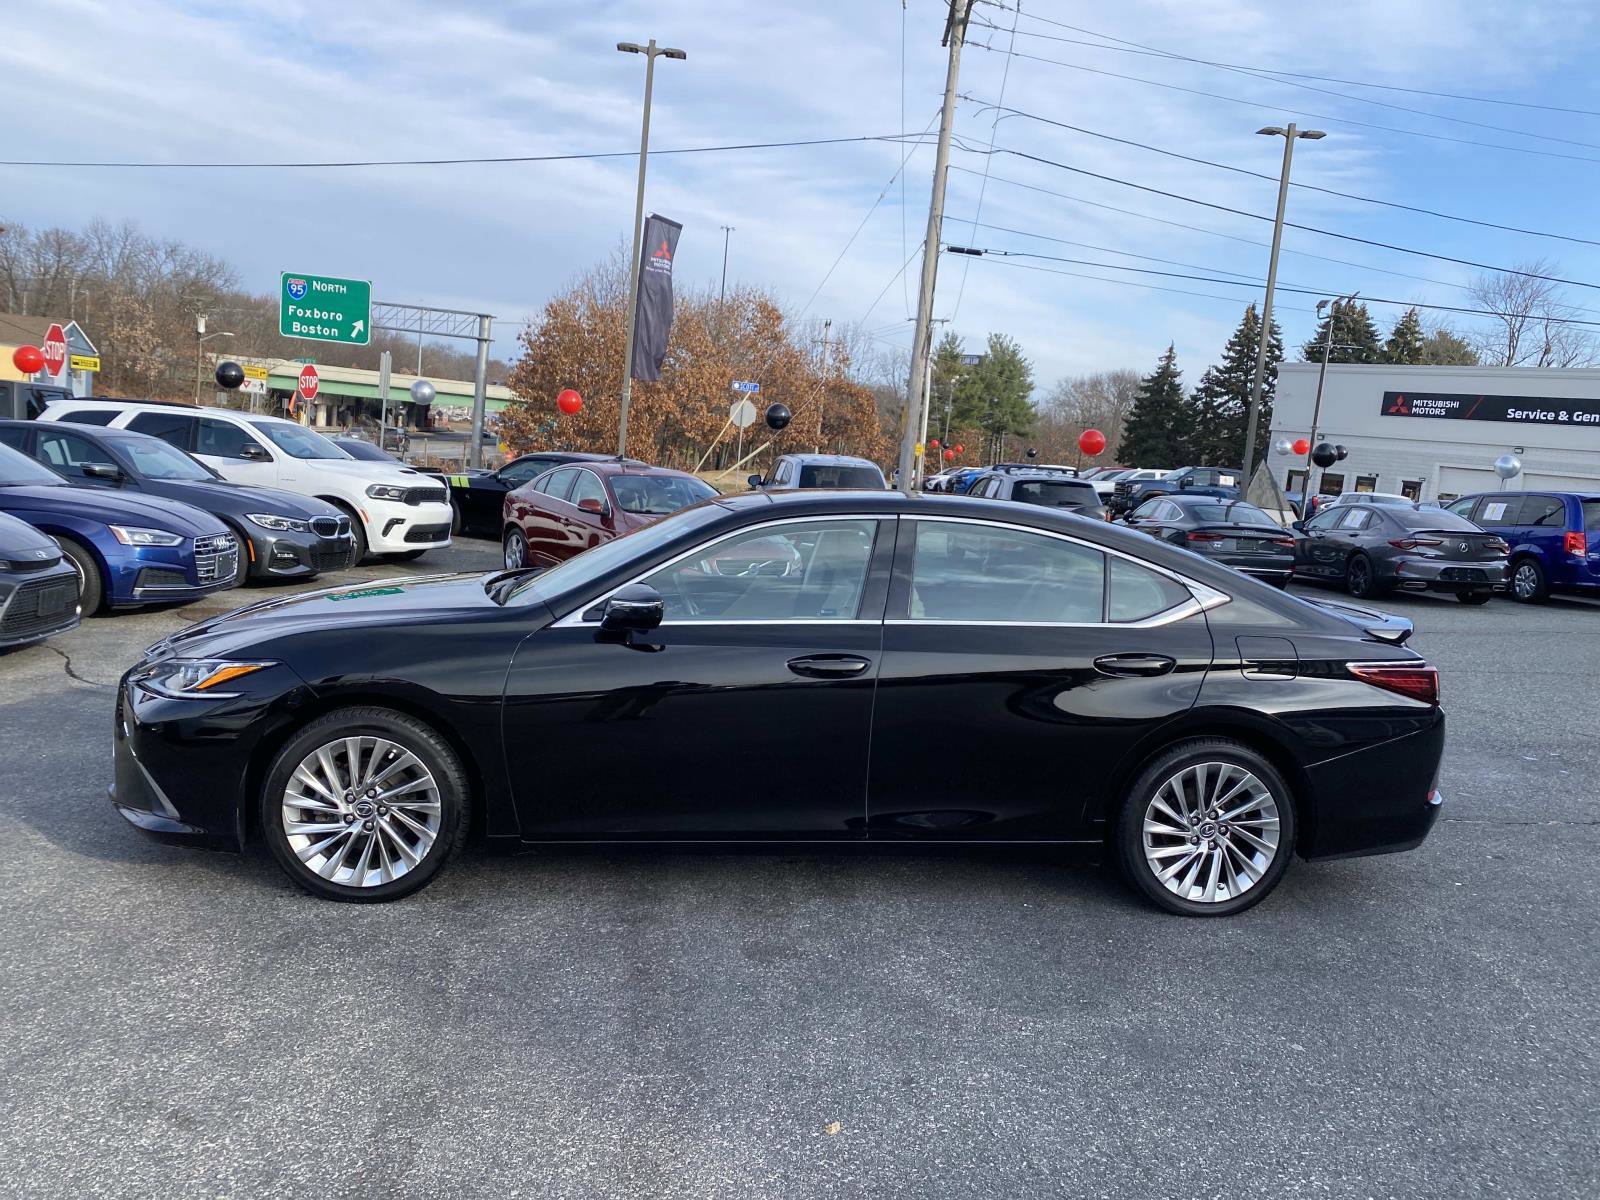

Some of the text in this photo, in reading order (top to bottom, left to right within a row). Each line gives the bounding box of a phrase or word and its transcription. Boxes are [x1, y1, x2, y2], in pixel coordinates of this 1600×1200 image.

[290, 280, 347, 295] 95 NORTH
[288, 305, 343, 321] Foxboro
[292, 321, 338, 337] Boston
[45, 341, 65, 361] STOP
[301, 375, 318, 389] STOP
[1411, 407, 1446, 416] MOTORS
[1412, 399, 1460, 409] MITSUBISHI
[1506, 408, 1600, 423] Service & Gen
